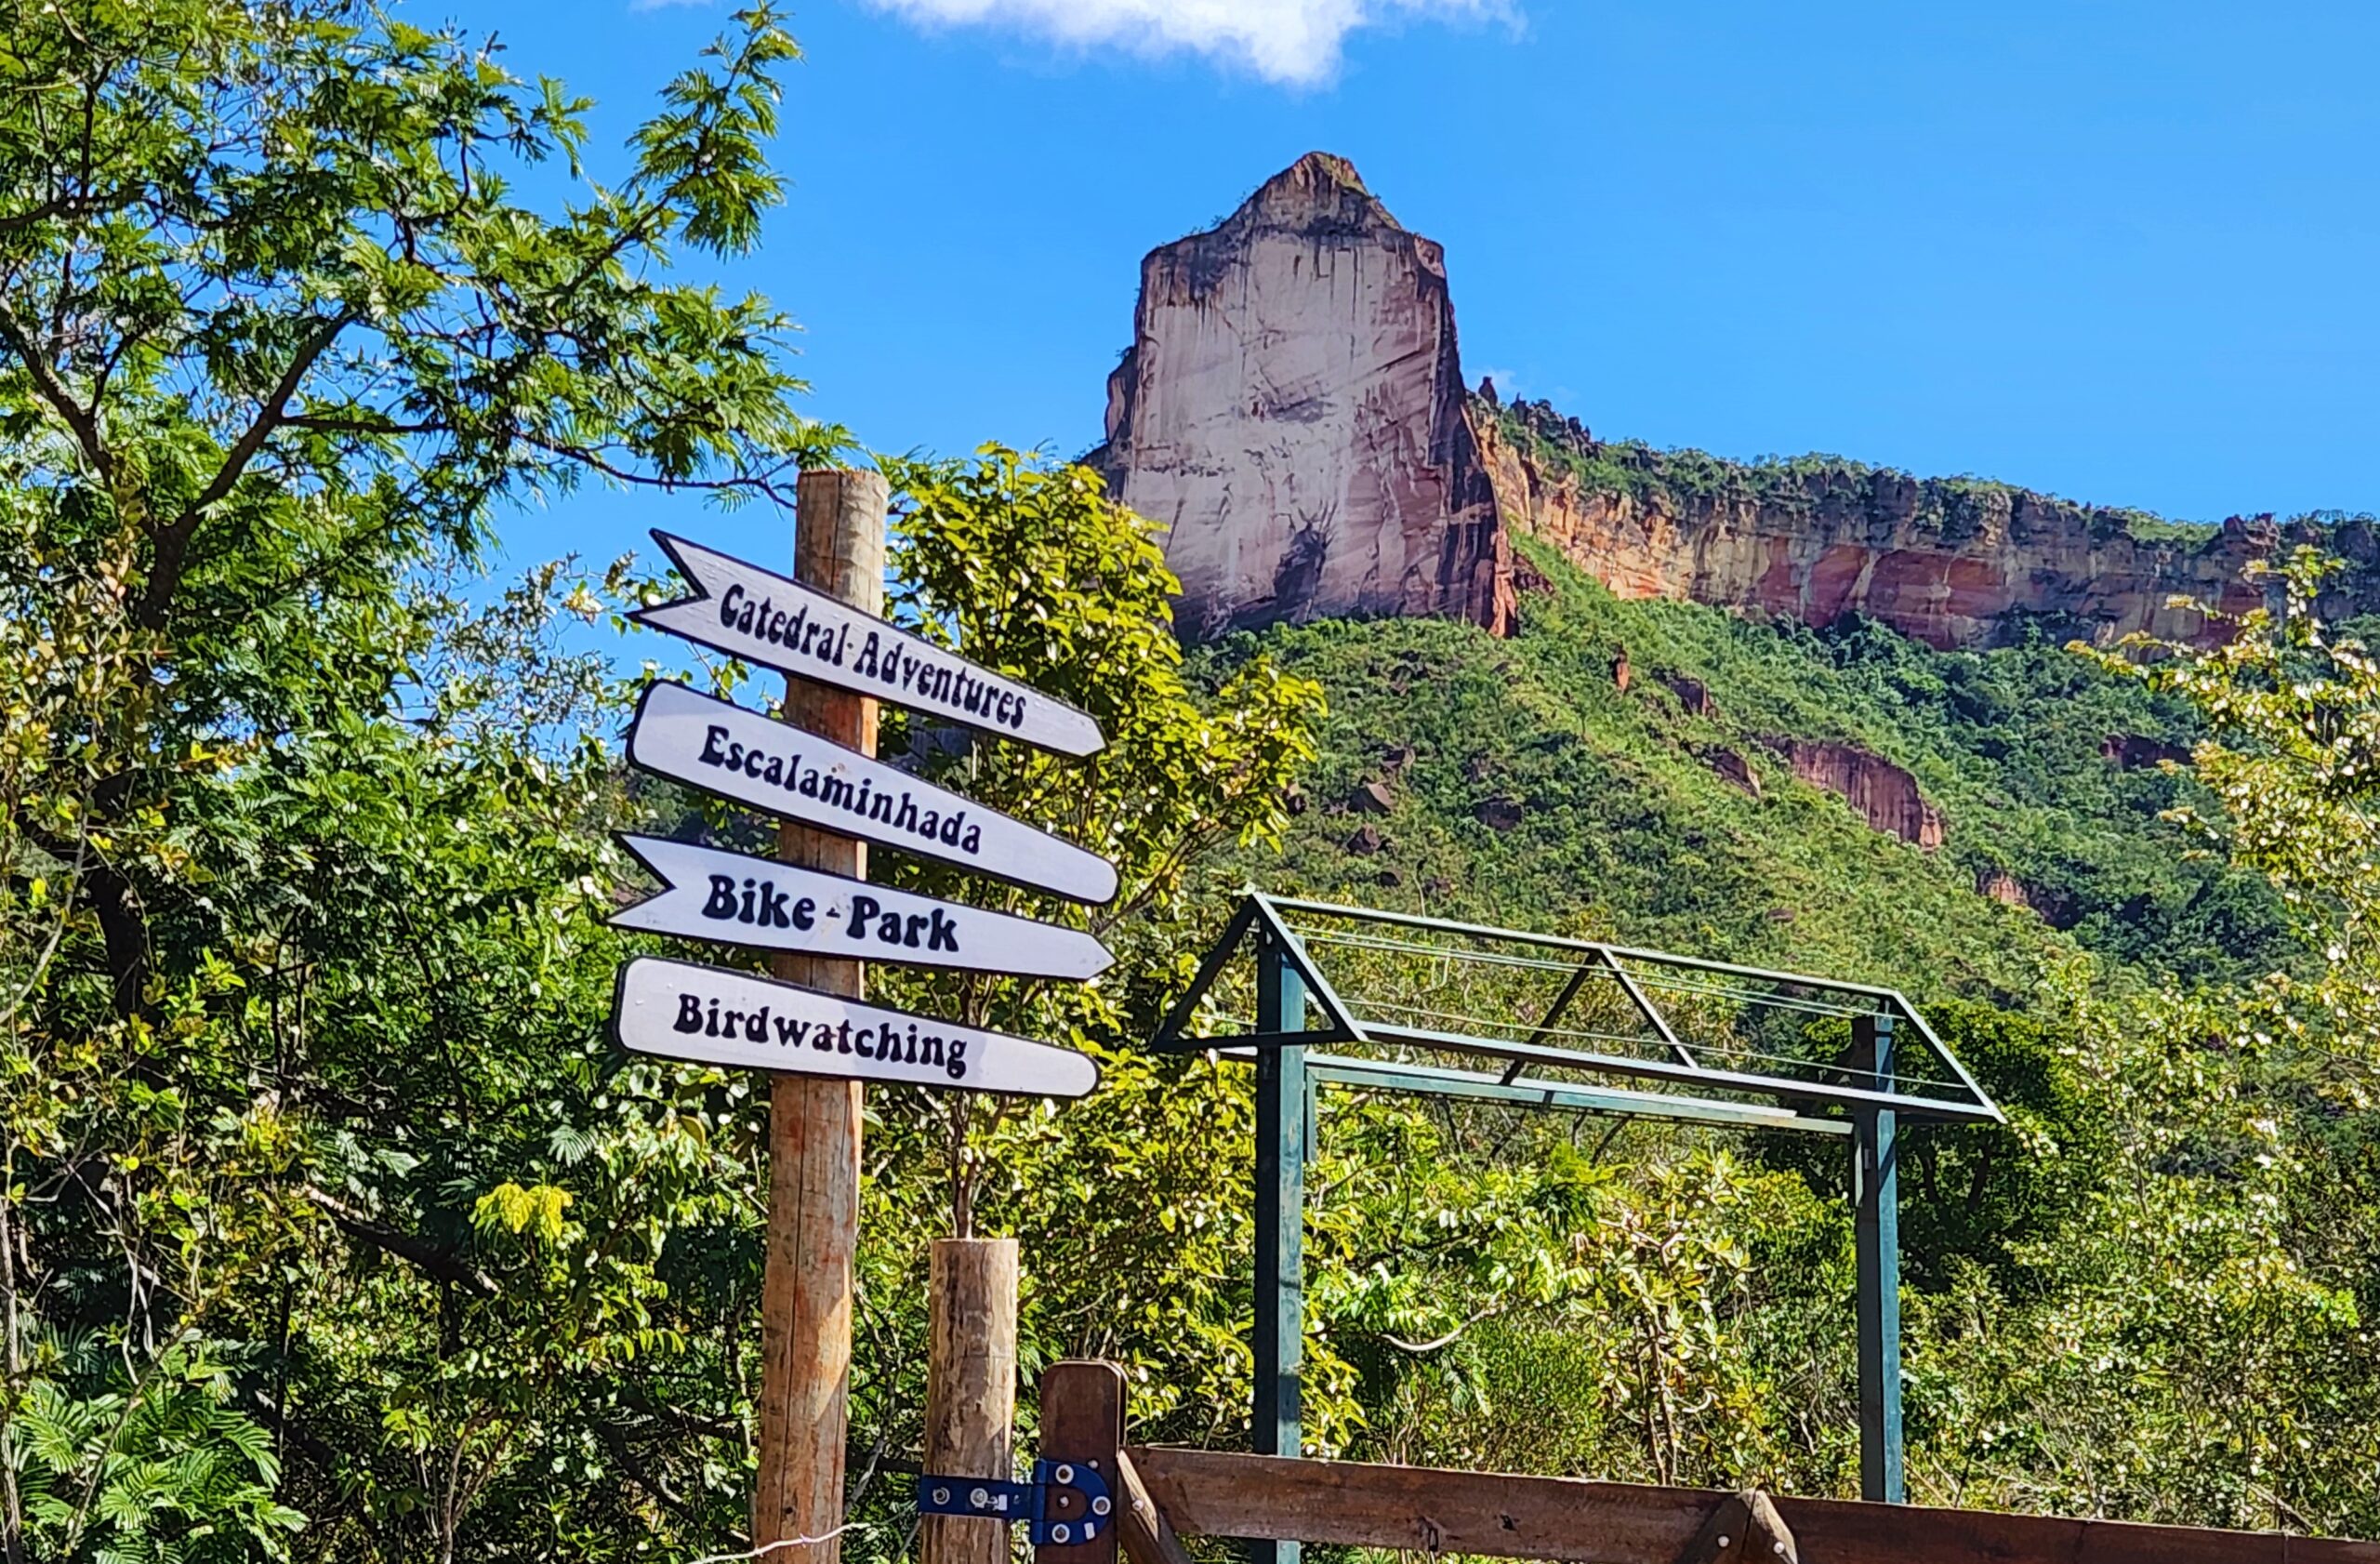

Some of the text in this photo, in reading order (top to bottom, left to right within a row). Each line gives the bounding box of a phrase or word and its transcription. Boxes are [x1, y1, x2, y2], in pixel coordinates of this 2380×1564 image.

[720, 583, 1027, 730] Catedral Adventures
[698, 724, 983, 855] Escalaminhada
[702, 874, 959, 952] Bike Park
[673, 993, 968, 1080] Birdwatching
